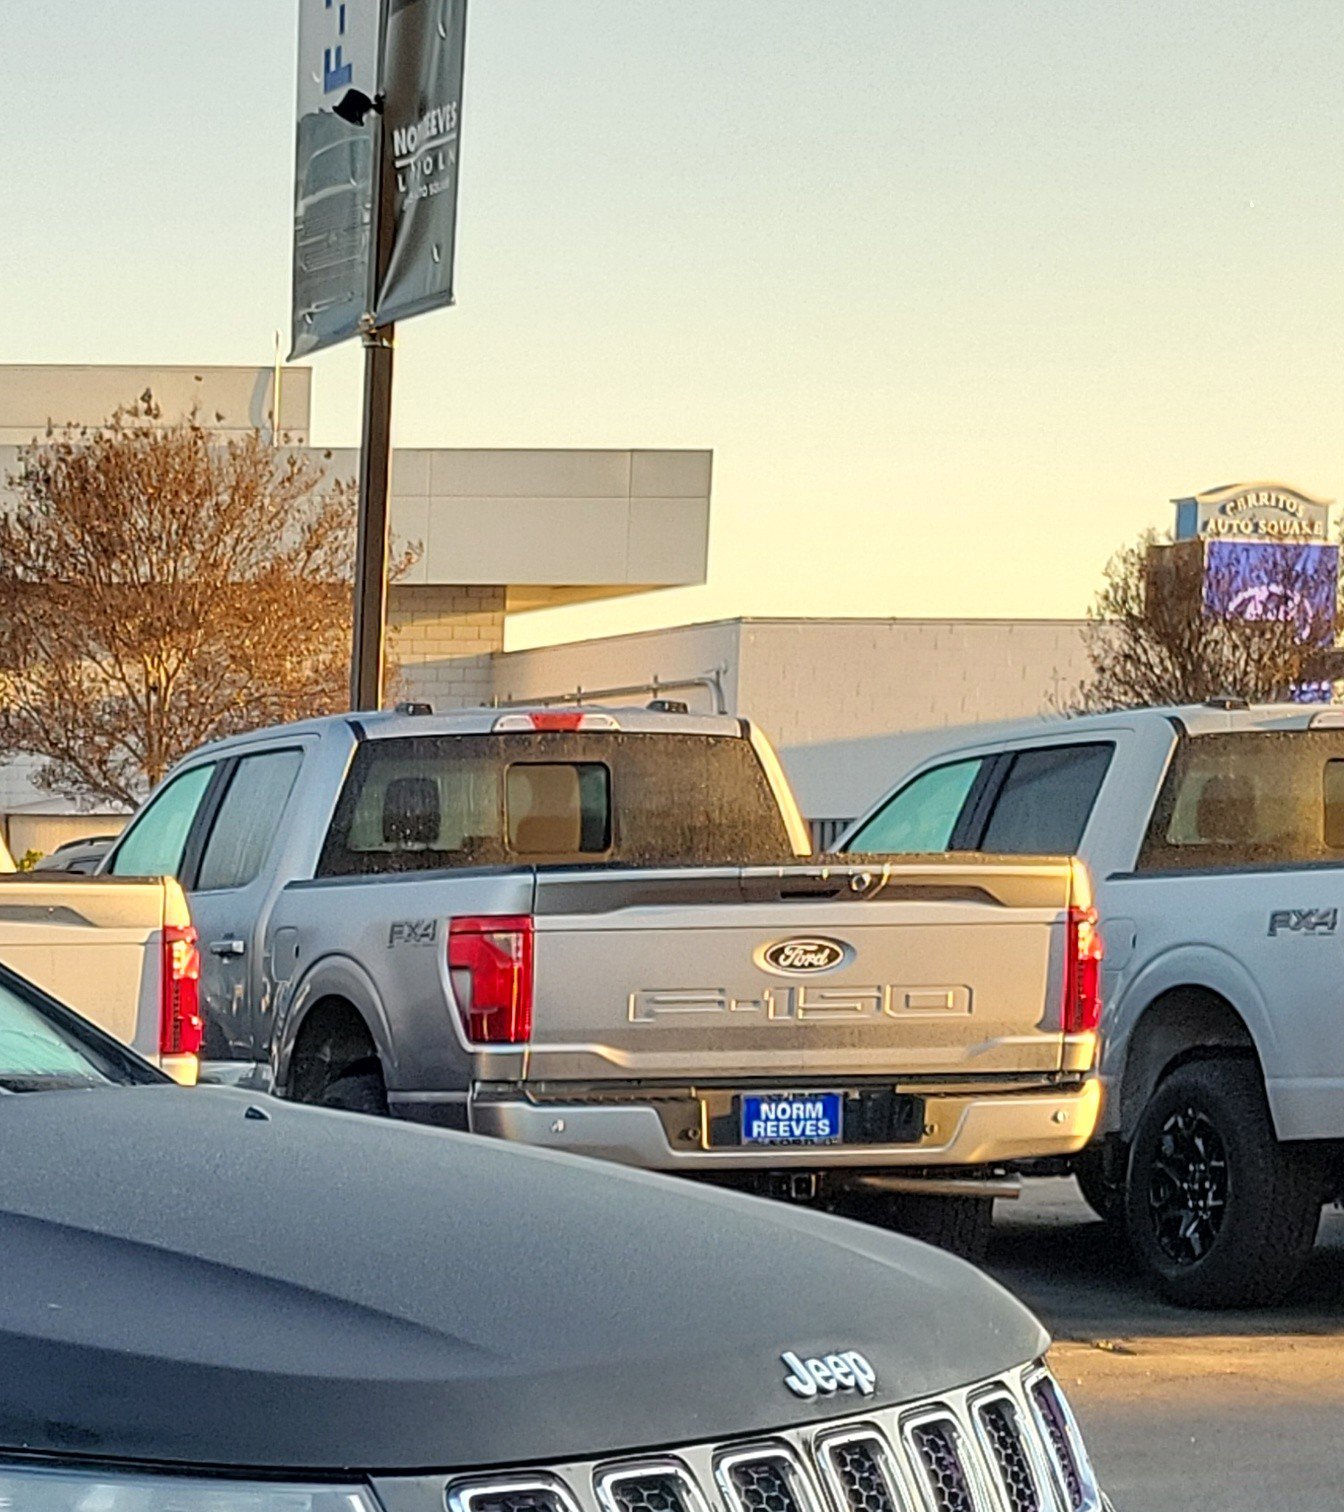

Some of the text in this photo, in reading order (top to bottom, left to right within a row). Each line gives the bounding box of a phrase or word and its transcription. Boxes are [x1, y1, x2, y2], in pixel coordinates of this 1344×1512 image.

[1206, 518, 1324, 536] AUTO SQUARE
[387, 919, 438, 949] FX4
[1267, 908, 1338, 937] FX4
[778, 944, 831, 967] Ford
[627, 983, 974, 1023] F-150
[759, 1101, 824, 1121] NORM
[752, 1118, 831, 1138] REEVES
[779, 1350, 877, 1398] Jeep
